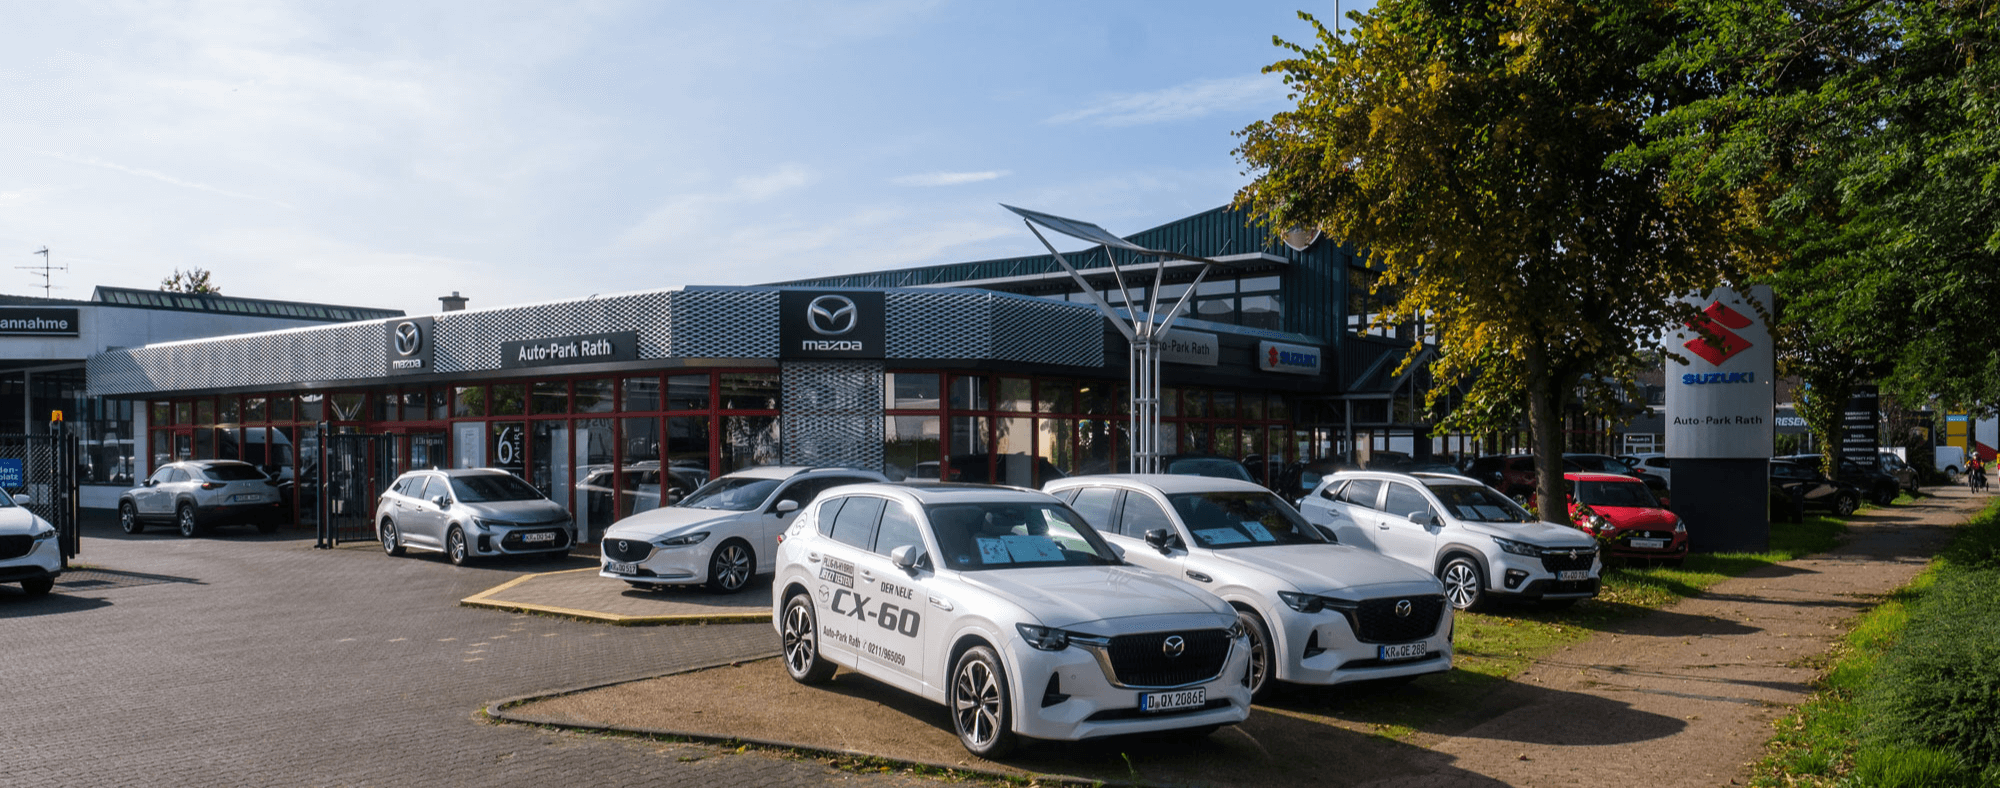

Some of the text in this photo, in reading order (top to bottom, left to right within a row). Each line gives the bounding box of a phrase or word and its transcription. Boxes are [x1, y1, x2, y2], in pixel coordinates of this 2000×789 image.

[0, 317, 68, 329] annahme
[518, 338, 611, 361] Auto-Park Rath
[802, 340, 862, 351] mazda
[1160, 339, 1210, 355] o-Park Rath
[392, 359, 421, 370] mazda
[1280, 351, 1317, 368] SUZUKI
[1682, 371, 1755, 385] SUZUKI
[1673, 415, 1763, 426] Auto-Park Rath
[497, 426, 513, 464] 6
[880, 581, 913, 600] DER NEUE
[831, 588, 920, 638] CX-60
[823, 625, 848, 644] Auto-Park
[848, 634, 861, 648] Rath
[1385, 643, 1425, 658] KR QE 288
[1148, 691, 1204, 708] D QX 2086E
